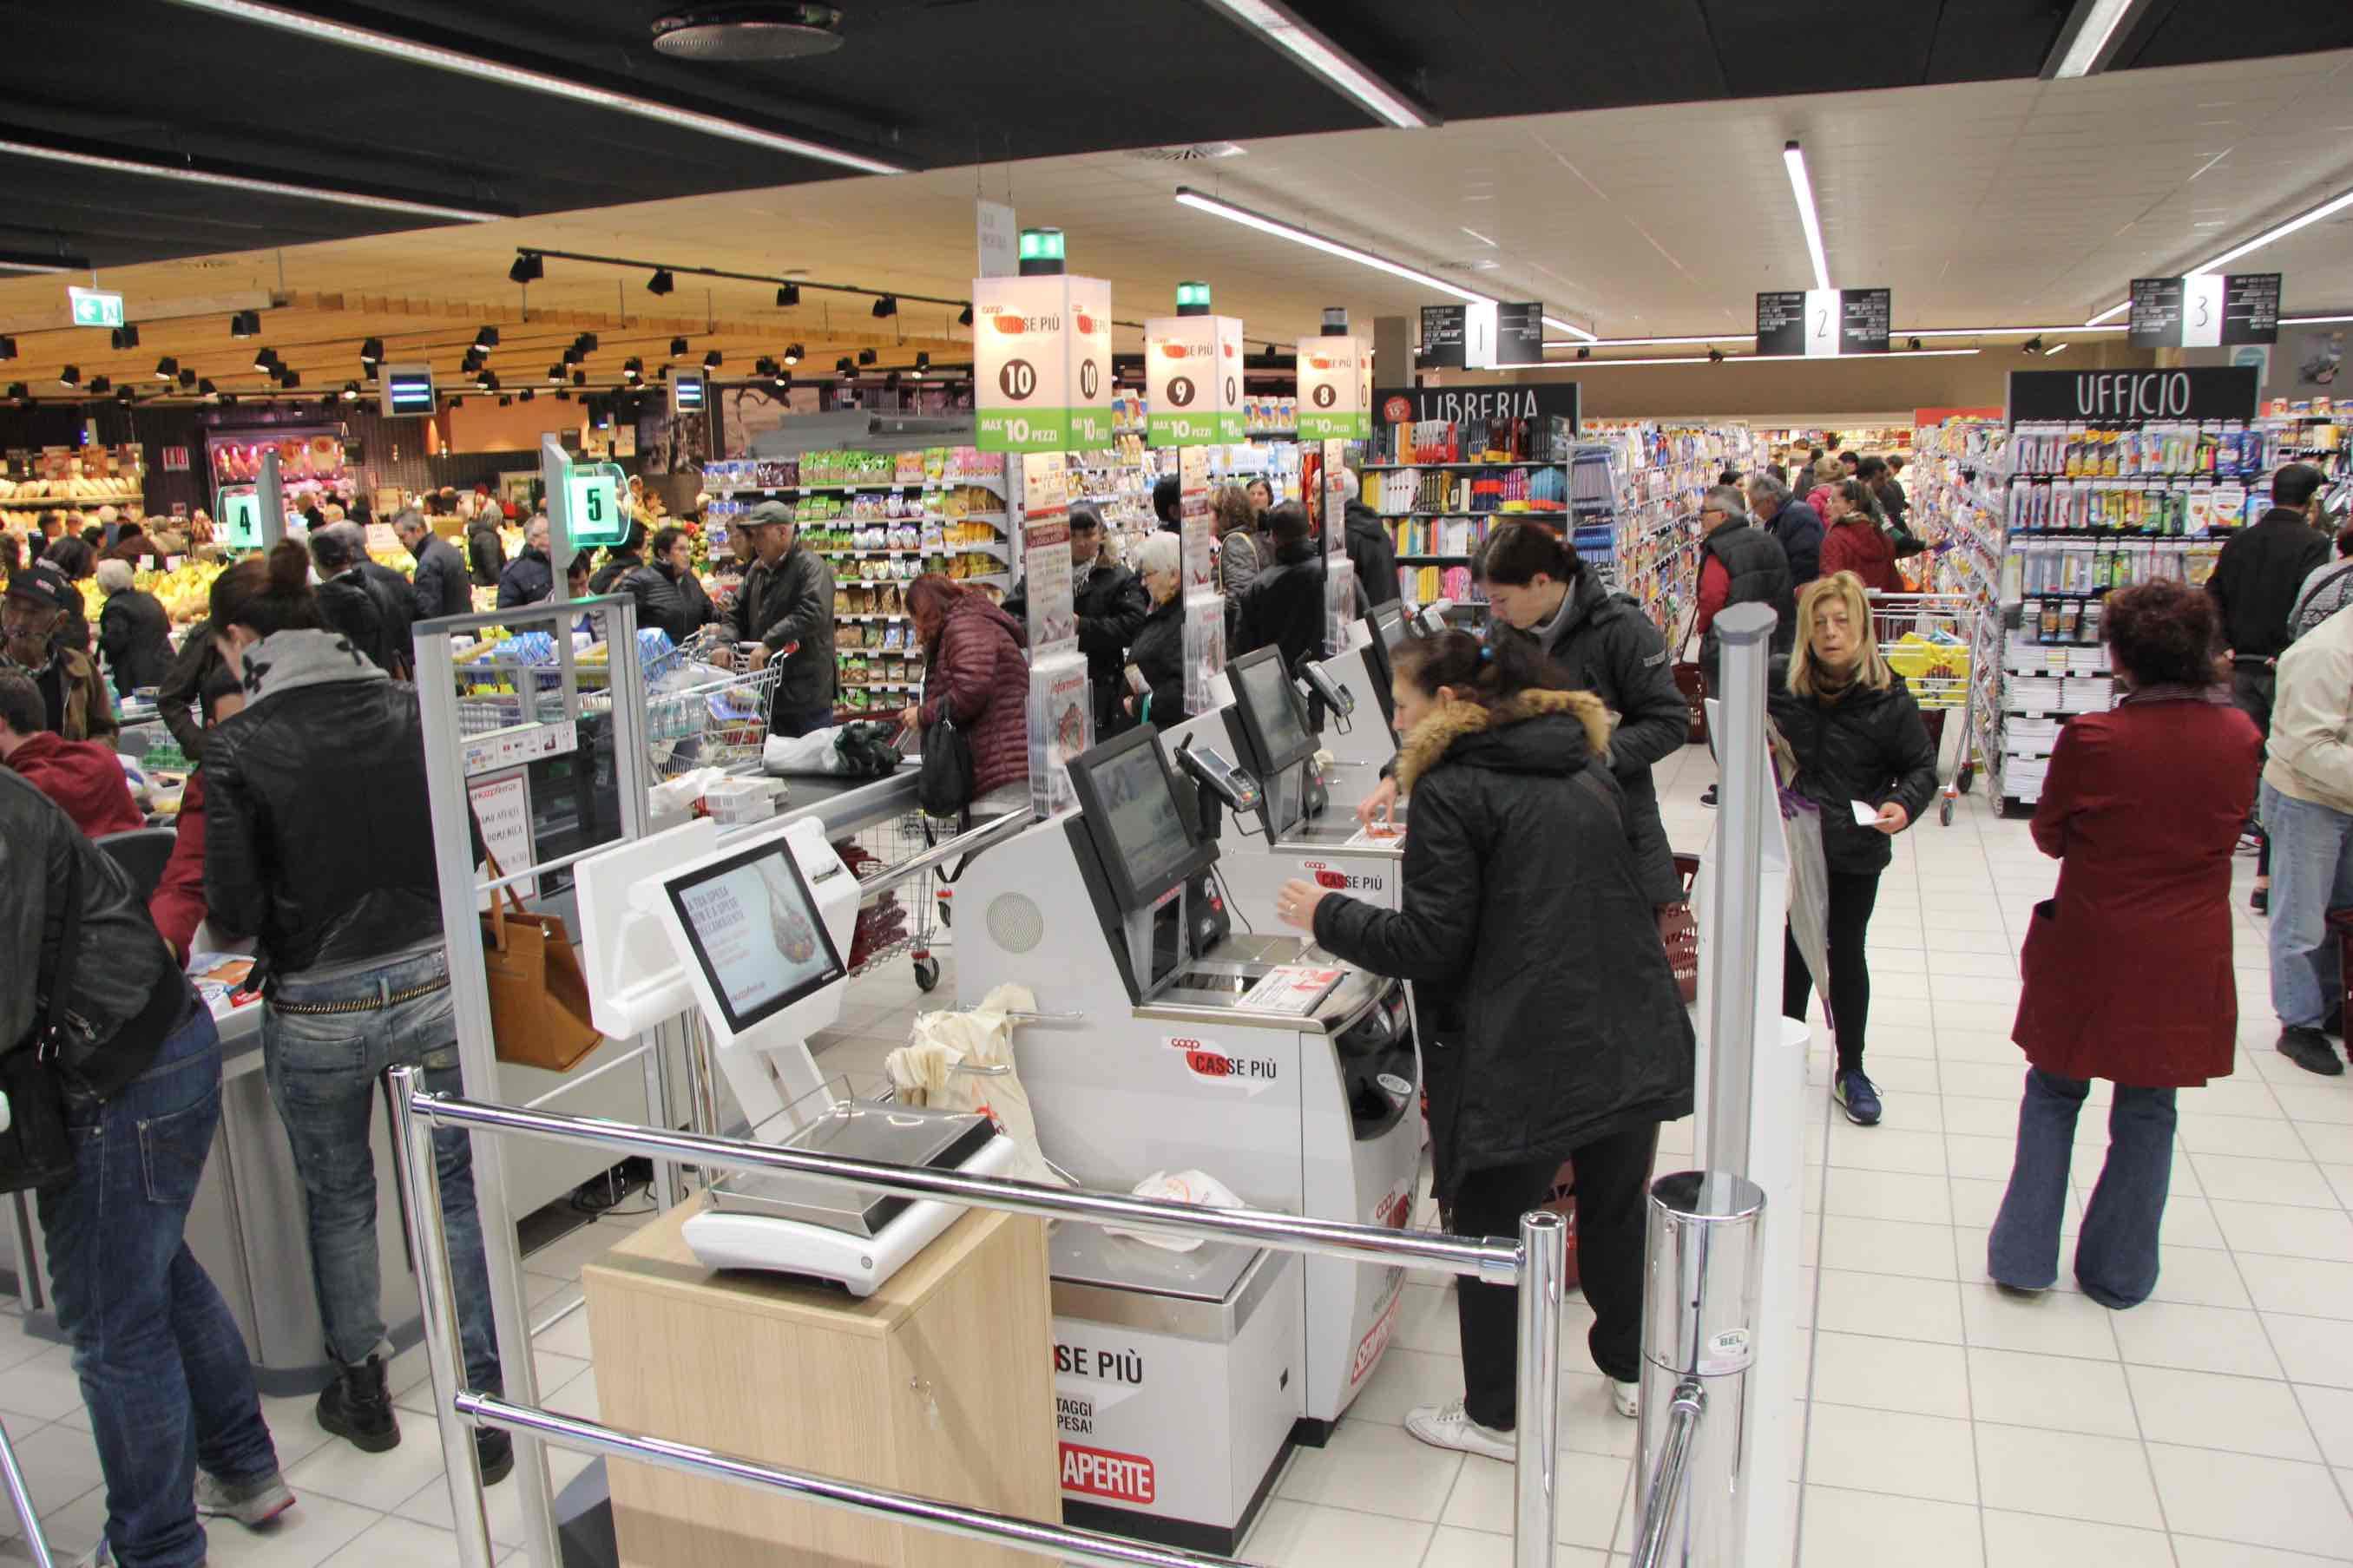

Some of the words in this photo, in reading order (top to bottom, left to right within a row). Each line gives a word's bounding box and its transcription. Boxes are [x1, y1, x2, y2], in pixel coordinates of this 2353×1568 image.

[1040, 312, 1060, 331] PIÙ
[1817, 309, 1827, 338] 2
[2194, 296, 2209, 327] 3
[1007, 364, 1032, 395] 10
[1084, 364, 1096, 394] 10
[1175, 381, 1187, 403] 9
[1320, 387, 1330, 405] 8
[1420, 390, 1538, 425] LIBRERIA
[2076, 372, 2191, 417] UFFICIO
[981, 417, 1002, 431] MAX
[1005, 418, 1029, 443] 10
[1032, 430, 1057, 442] PEZZI
[1152, 418, 1169, 431] MAX
[1170, 419, 1190, 438] 10
[1317, 418, 1331, 433] 10
[587, 489, 601, 522] 5
[240, 506, 251, 535] 4
[1305, 861, 1326, 872] coop
[1322, 873, 1359, 889] CASSE
[1363, 875, 1382, 890] PIÙ
[1172, 1038, 1200, 1052] coop
[1194, 1053, 1245, 1075] CASSE
[1250, 1057, 1277, 1079] PIÙ
[1055, 1344, 1088, 1375] SE
[1098, 1348, 1143, 1384] PIÙ
[1056, 1397, 1092, 1417] TAGGI
[1057, 1414, 1093, 1434] PESA!
[1062, 1450, 1152, 1499] APERTE
